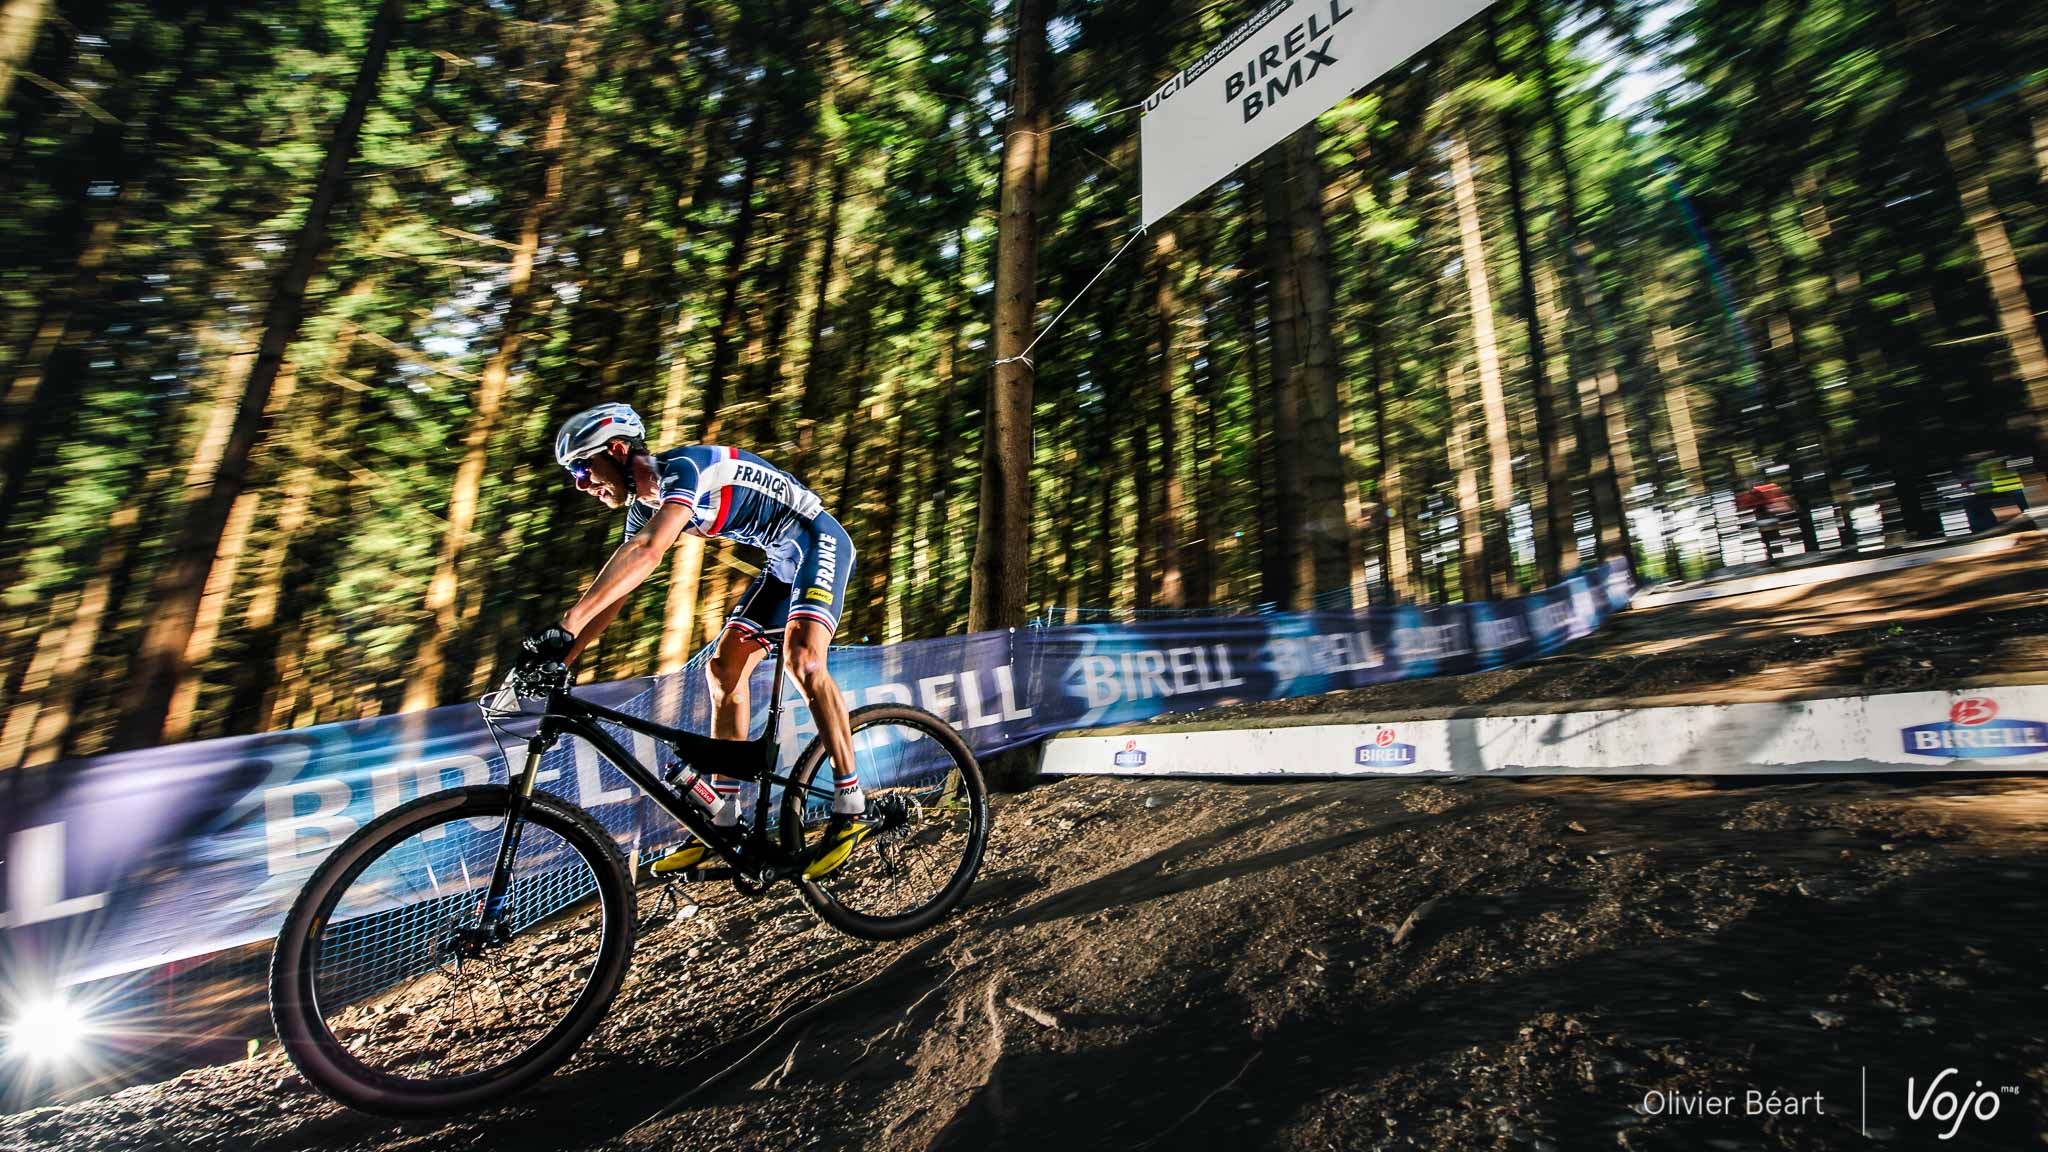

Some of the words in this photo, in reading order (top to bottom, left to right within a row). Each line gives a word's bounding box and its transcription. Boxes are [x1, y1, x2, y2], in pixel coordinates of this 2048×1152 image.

[1187, 56, 1216, 81] WORLD
[1216, 1, 1287, 59] CHAMPIONSHIPS
[1204, 23, 1247, 61] MOUNTAIN
[1249, 7, 1268, 26] BIKE
[1225, 0, 1353, 104] BIRELL
[1147, 77, 1181, 112] UCI
[1243, 34, 1338, 124] BMX
[733, 464, 787, 498] FRANCE
[815, 533, 837, 591] FRANCE
[1082, 643, 1246, 709] BIRELL
[1359, 748, 1411, 762] BIRELL
[1915, 728, 2048, 750] BIRELL
